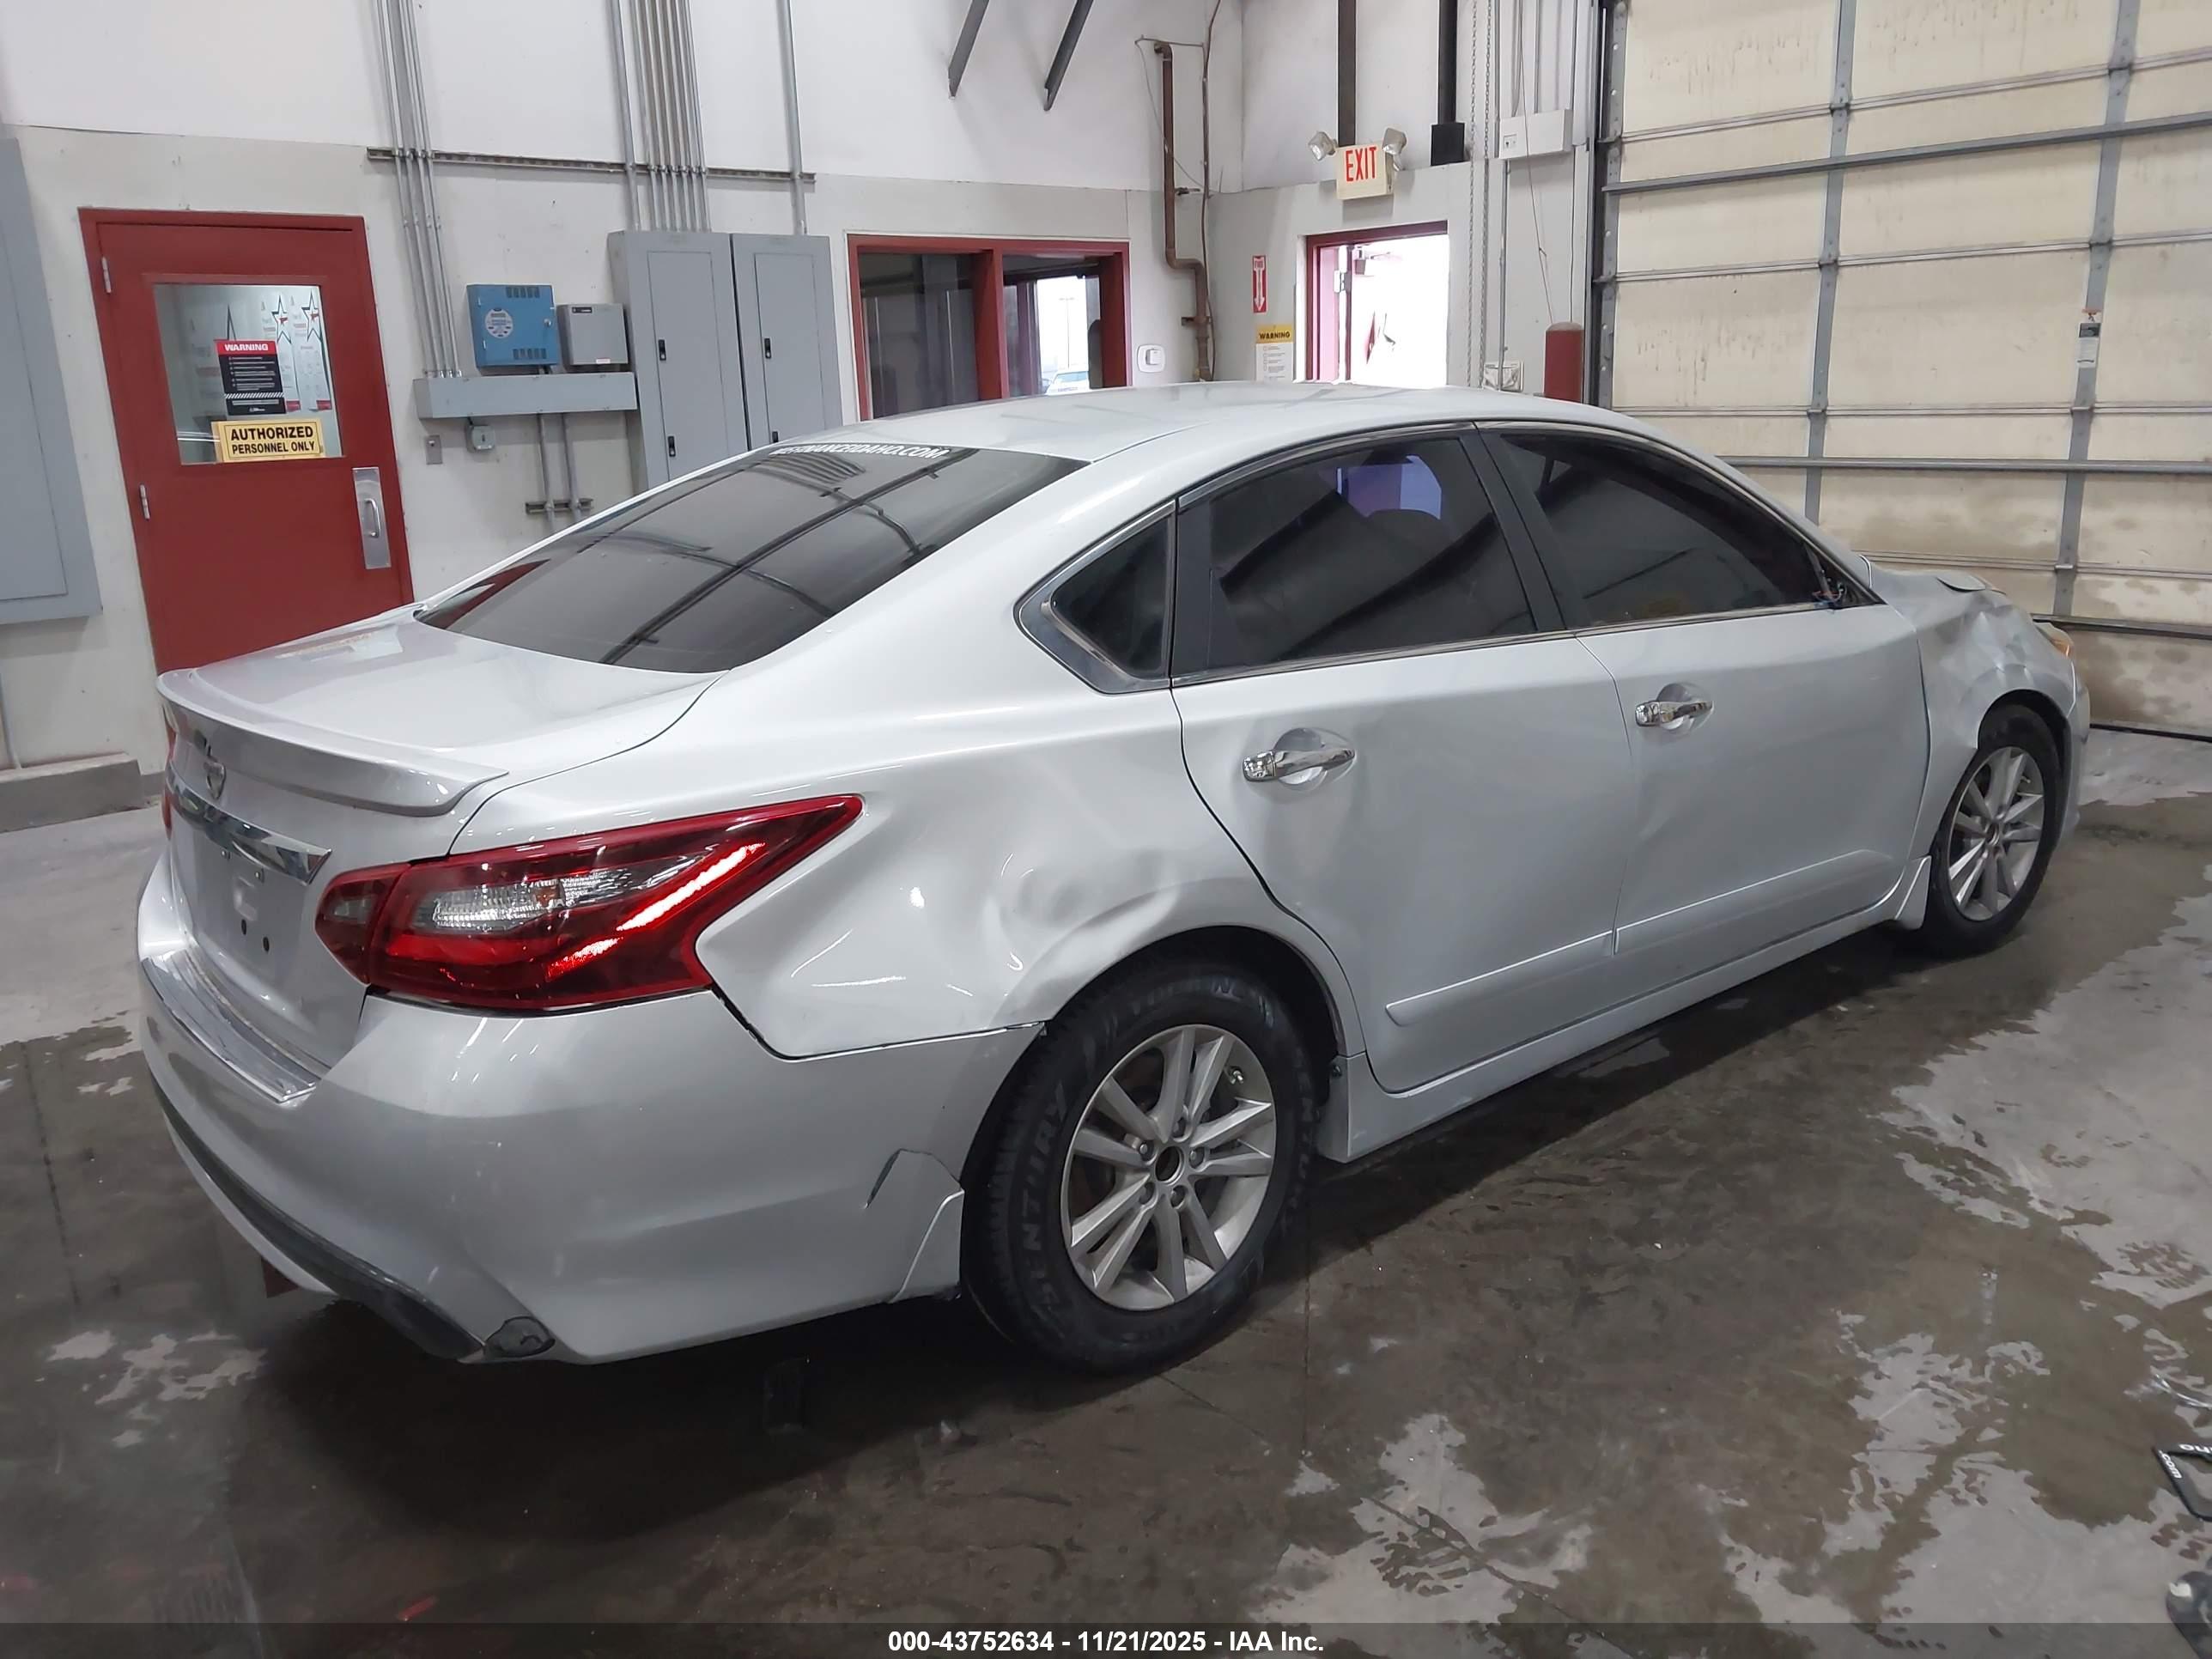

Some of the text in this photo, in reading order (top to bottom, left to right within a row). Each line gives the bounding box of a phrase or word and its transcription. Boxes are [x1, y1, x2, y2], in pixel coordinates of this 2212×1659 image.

[1346, 147, 1376, 181] EXIT
[1259, 331, 1291, 339] WARNING
[224, 343, 269, 351] WARNING
[231, 426, 313, 441] AUTHORIZED
[232, 441, 315, 454] PERSONNEL ONLY
